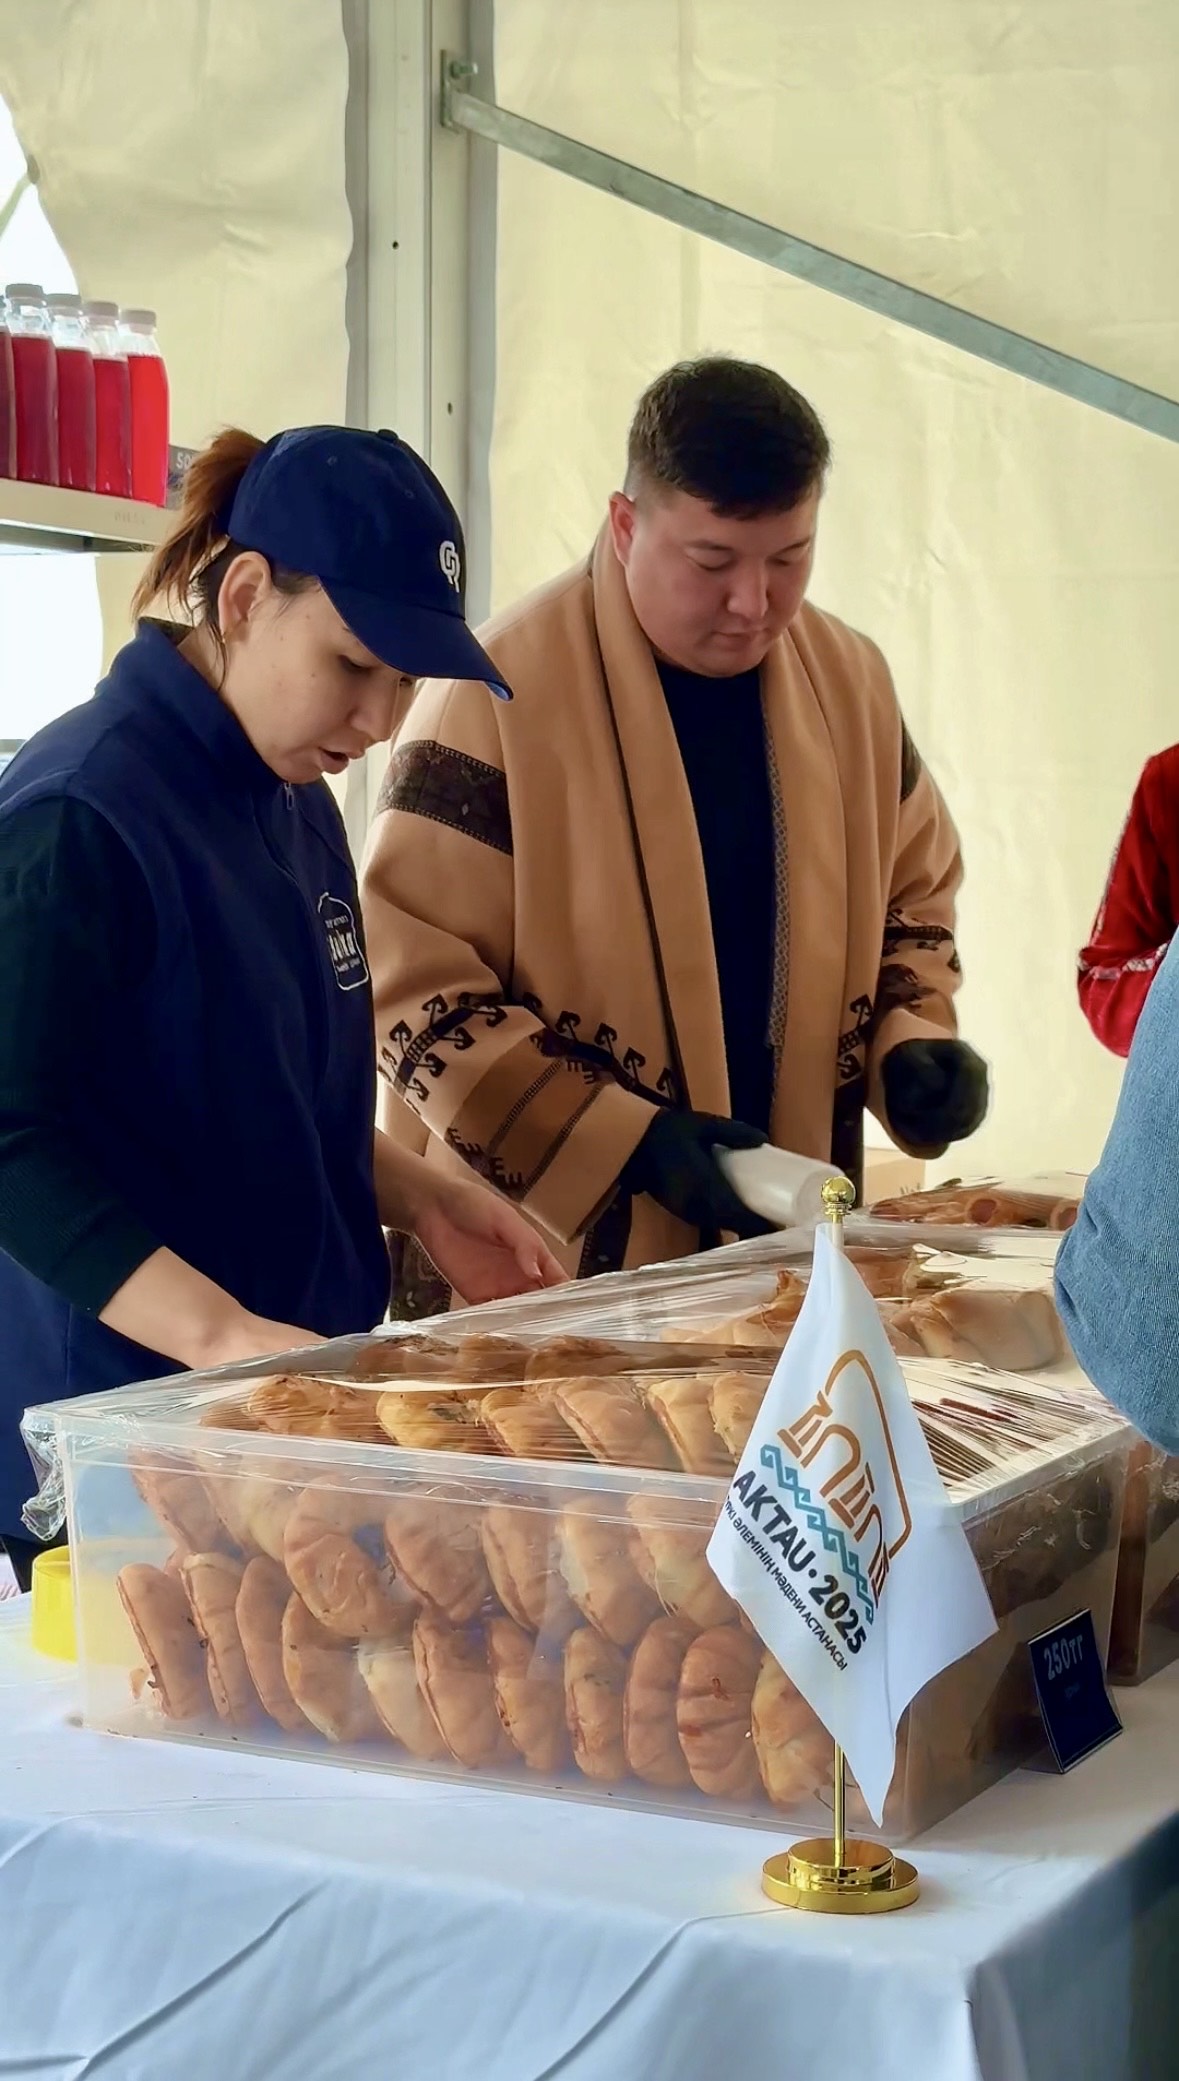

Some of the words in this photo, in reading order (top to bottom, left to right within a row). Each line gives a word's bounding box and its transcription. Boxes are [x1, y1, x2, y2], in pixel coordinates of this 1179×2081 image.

[733, 1470, 816, 1572] AKTAU
[808, 1574, 867, 1654] 2025
[733, 1517, 775, 1572] ӘЛЕМІНІҢ
[771, 1567, 807, 1614] МӘДЕНИ
[801, 1612, 848, 1671] АСТАНАСЫ
